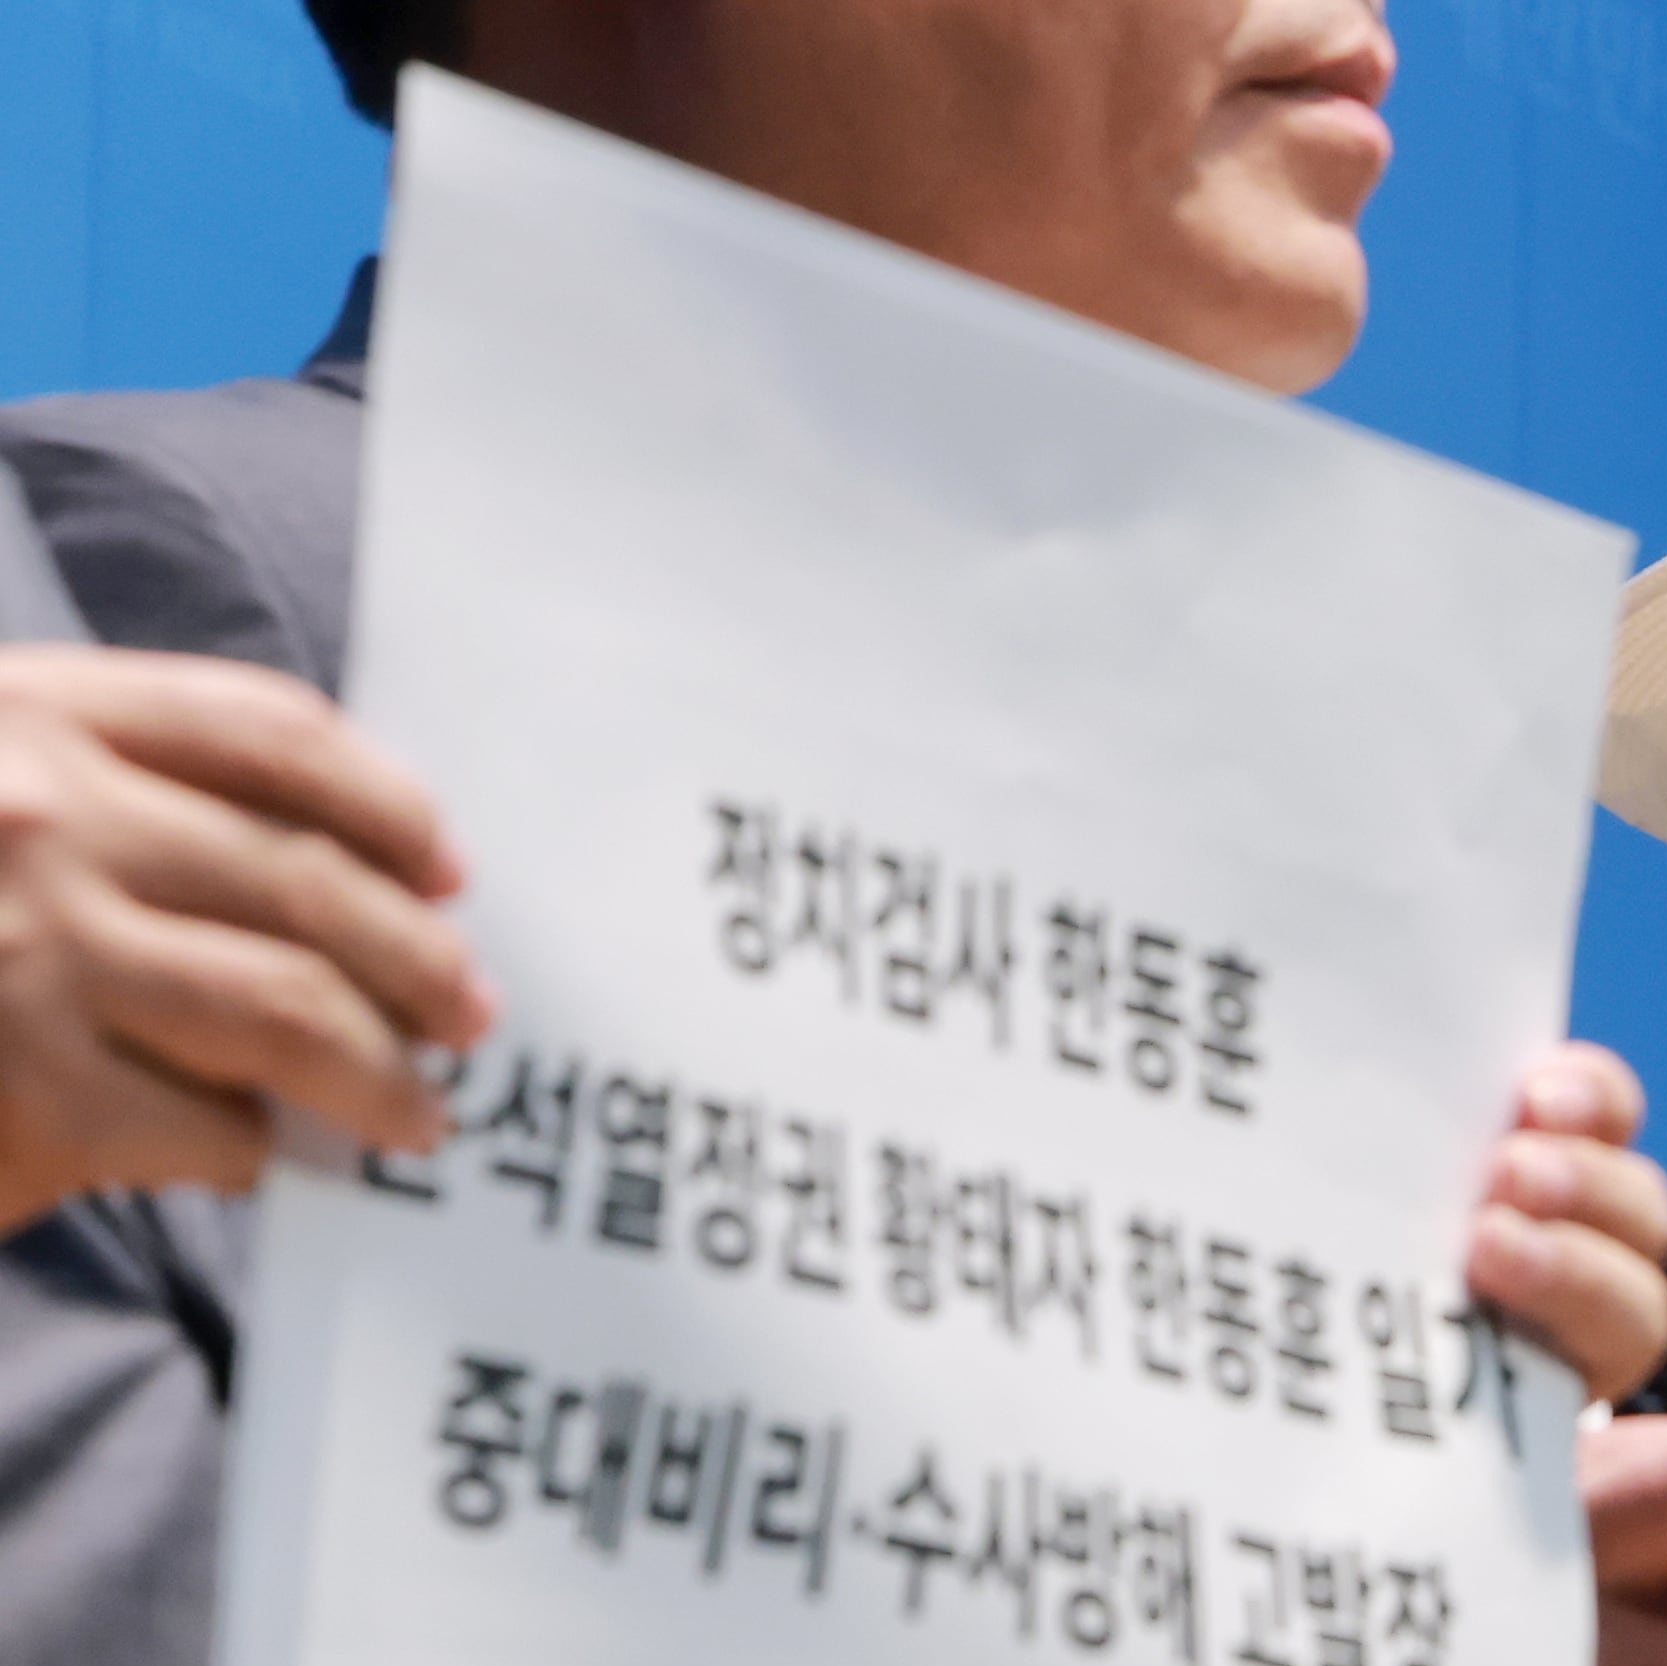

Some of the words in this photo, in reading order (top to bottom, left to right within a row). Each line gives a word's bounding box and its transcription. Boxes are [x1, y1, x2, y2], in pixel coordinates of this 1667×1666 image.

[704, 797, 1018, 1050] 정치검사
[1040, 895, 1266, 1120] 한동훈
[873, 1135, 1100, 1360] 황태자
[1122, 1208, 1335, 1420] 한동훈
